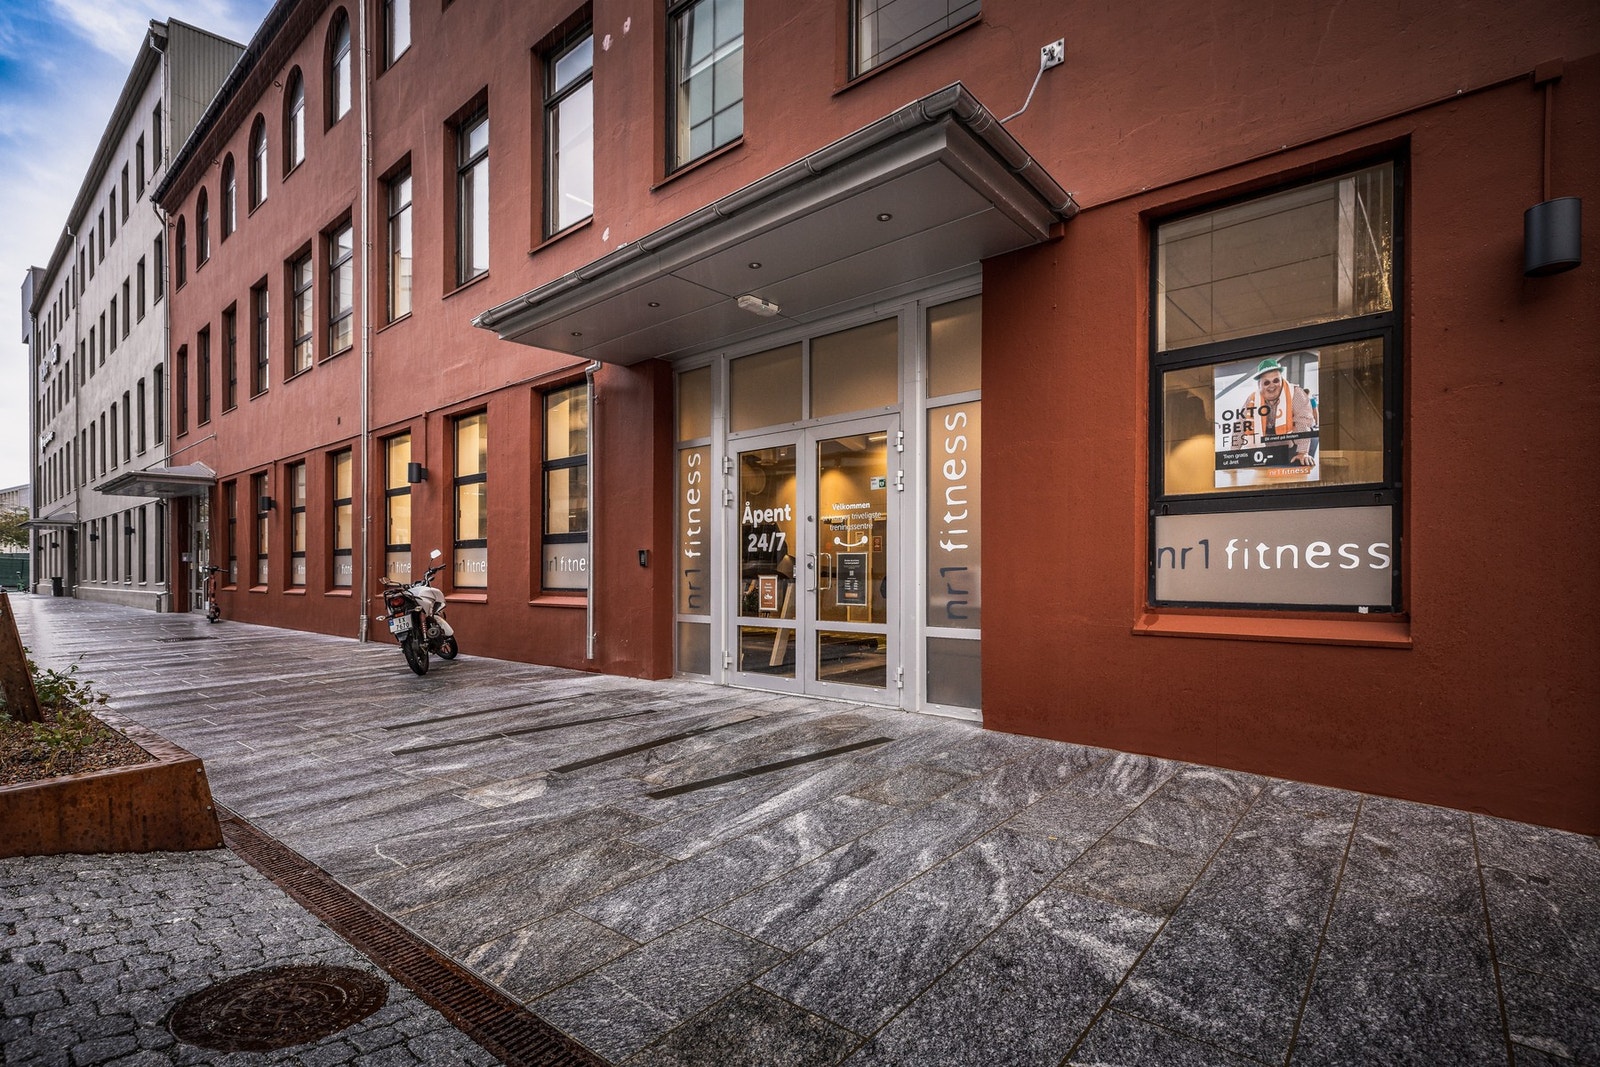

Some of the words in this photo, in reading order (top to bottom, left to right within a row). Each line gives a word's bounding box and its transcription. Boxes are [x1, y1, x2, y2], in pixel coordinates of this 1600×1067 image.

[1222, 405, 1271, 421] OKTO
[1222, 421, 1253, 434] BER
[1222, 432, 1259, 447] FEST
[940, 411, 968, 552] fitness
[684, 453, 701, 558] fitness
[742, 501, 792, 528] Åpent
[832, 502, 871, 510] Velkommen
[747, 532, 786, 552] 24/7
[560, 555, 588, 572] fitne
[1157, 539, 1210, 570] nr1
[1225, 538, 1391, 570] fitness
[467, 559, 487, 573] fitne
[684, 569, 701, 609] nr1
[940, 566, 968, 619] nr1
